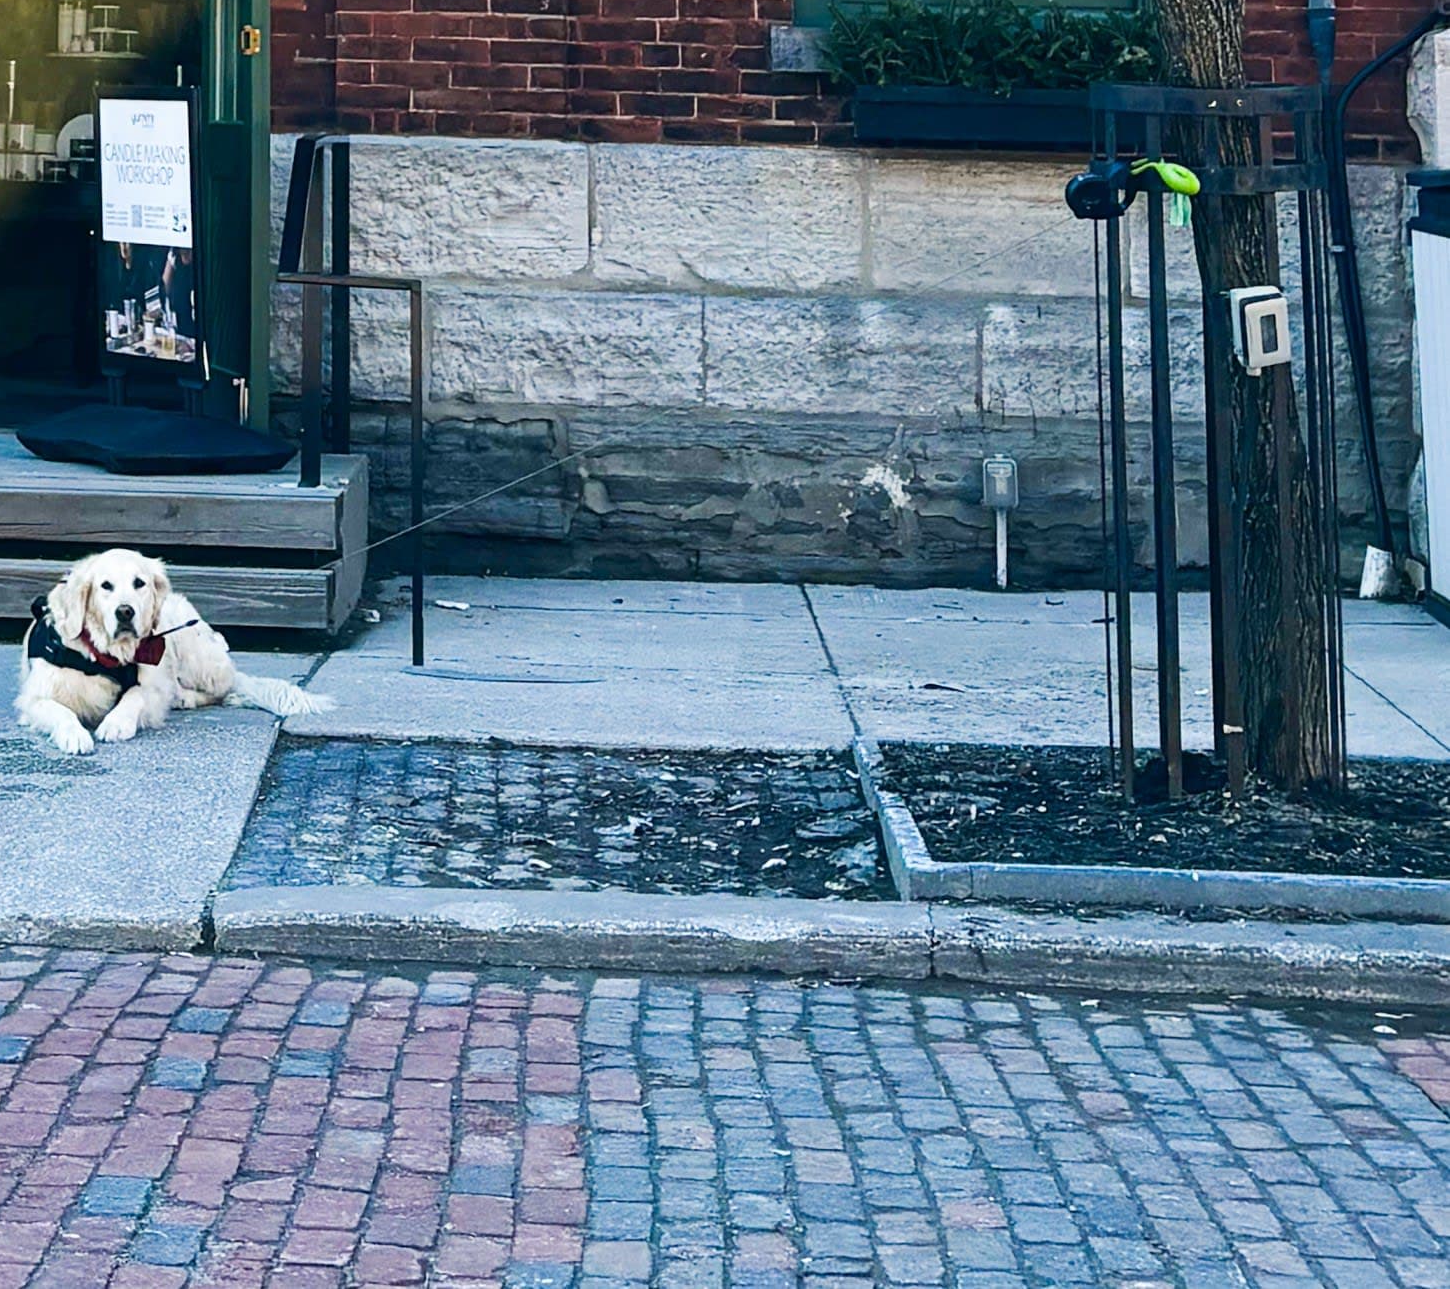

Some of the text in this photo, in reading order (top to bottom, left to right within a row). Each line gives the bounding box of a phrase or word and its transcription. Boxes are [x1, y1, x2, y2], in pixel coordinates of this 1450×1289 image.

[104, 142, 186, 165] CANDLE MAKING
[116, 164, 174, 186] WORKSHOP
